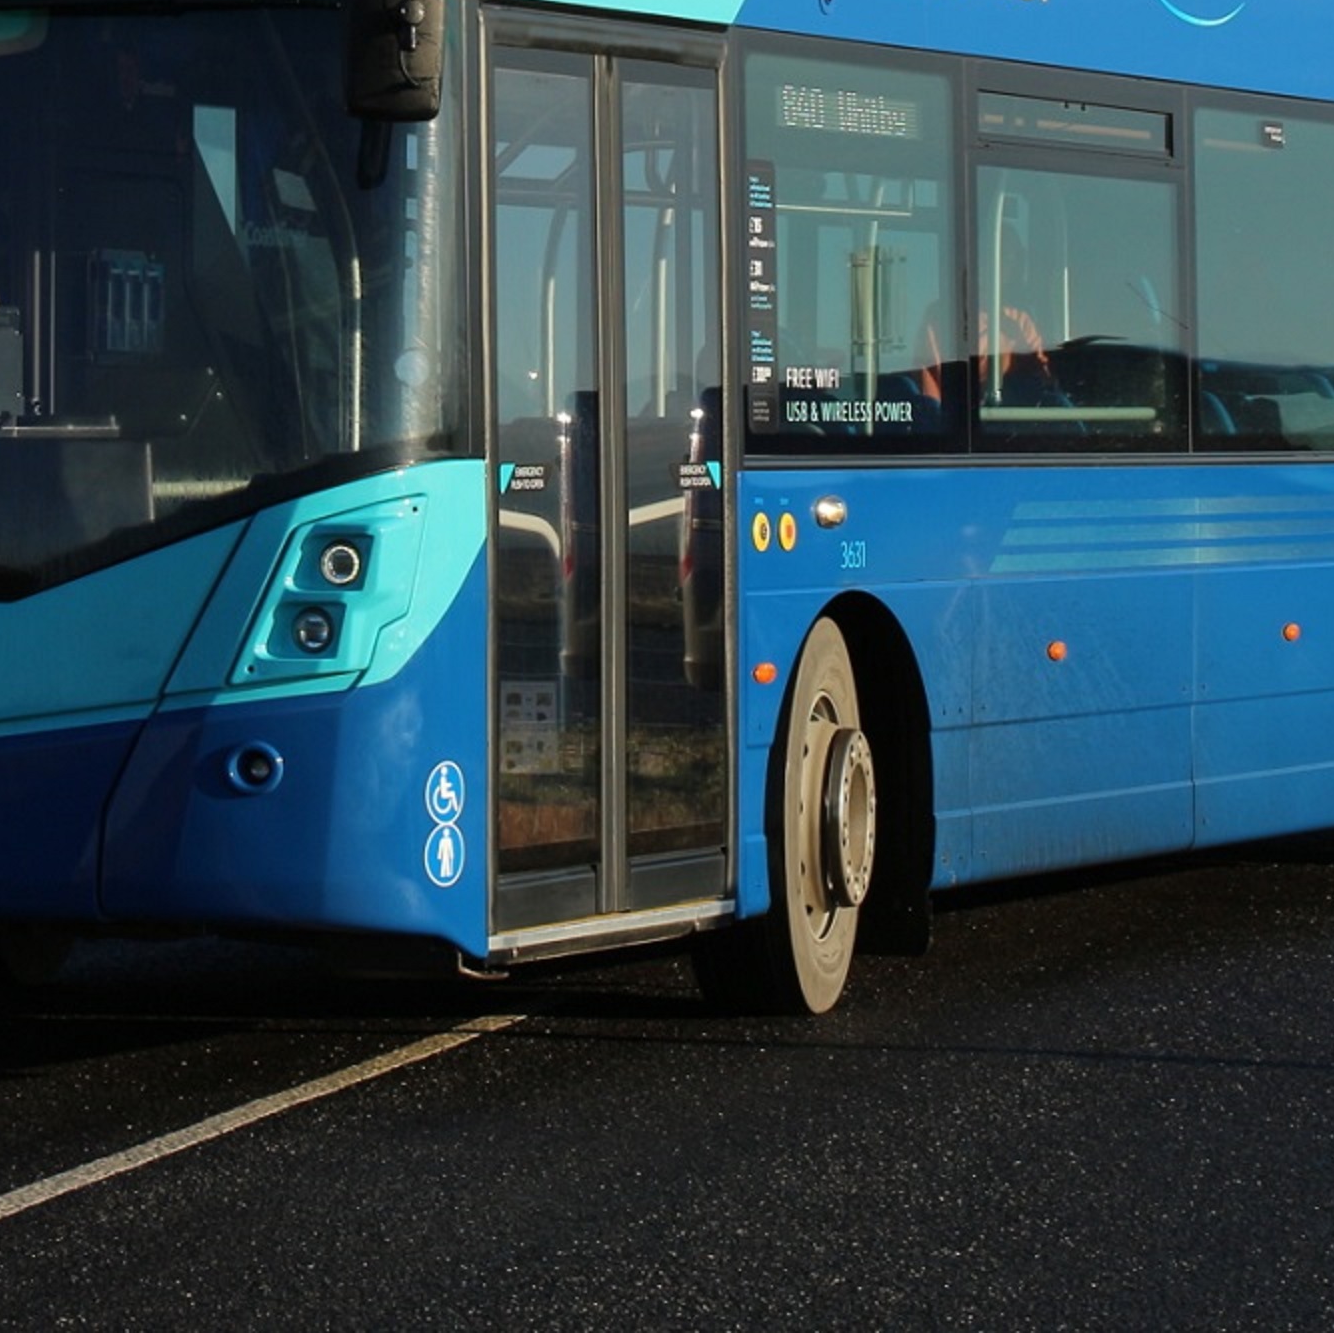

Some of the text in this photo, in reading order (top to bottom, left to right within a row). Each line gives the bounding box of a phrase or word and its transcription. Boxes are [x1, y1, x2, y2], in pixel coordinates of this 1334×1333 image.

[786, 367, 812, 389] FREE
[814, 368, 840, 389] WIFI
[786, 400, 808, 422] USB
[810, 400, 819, 422] &
[820, 401, 871, 422] WIRELESS
[874, 401, 914, 422] POWER
[839, 540, 866, 569] 3631
